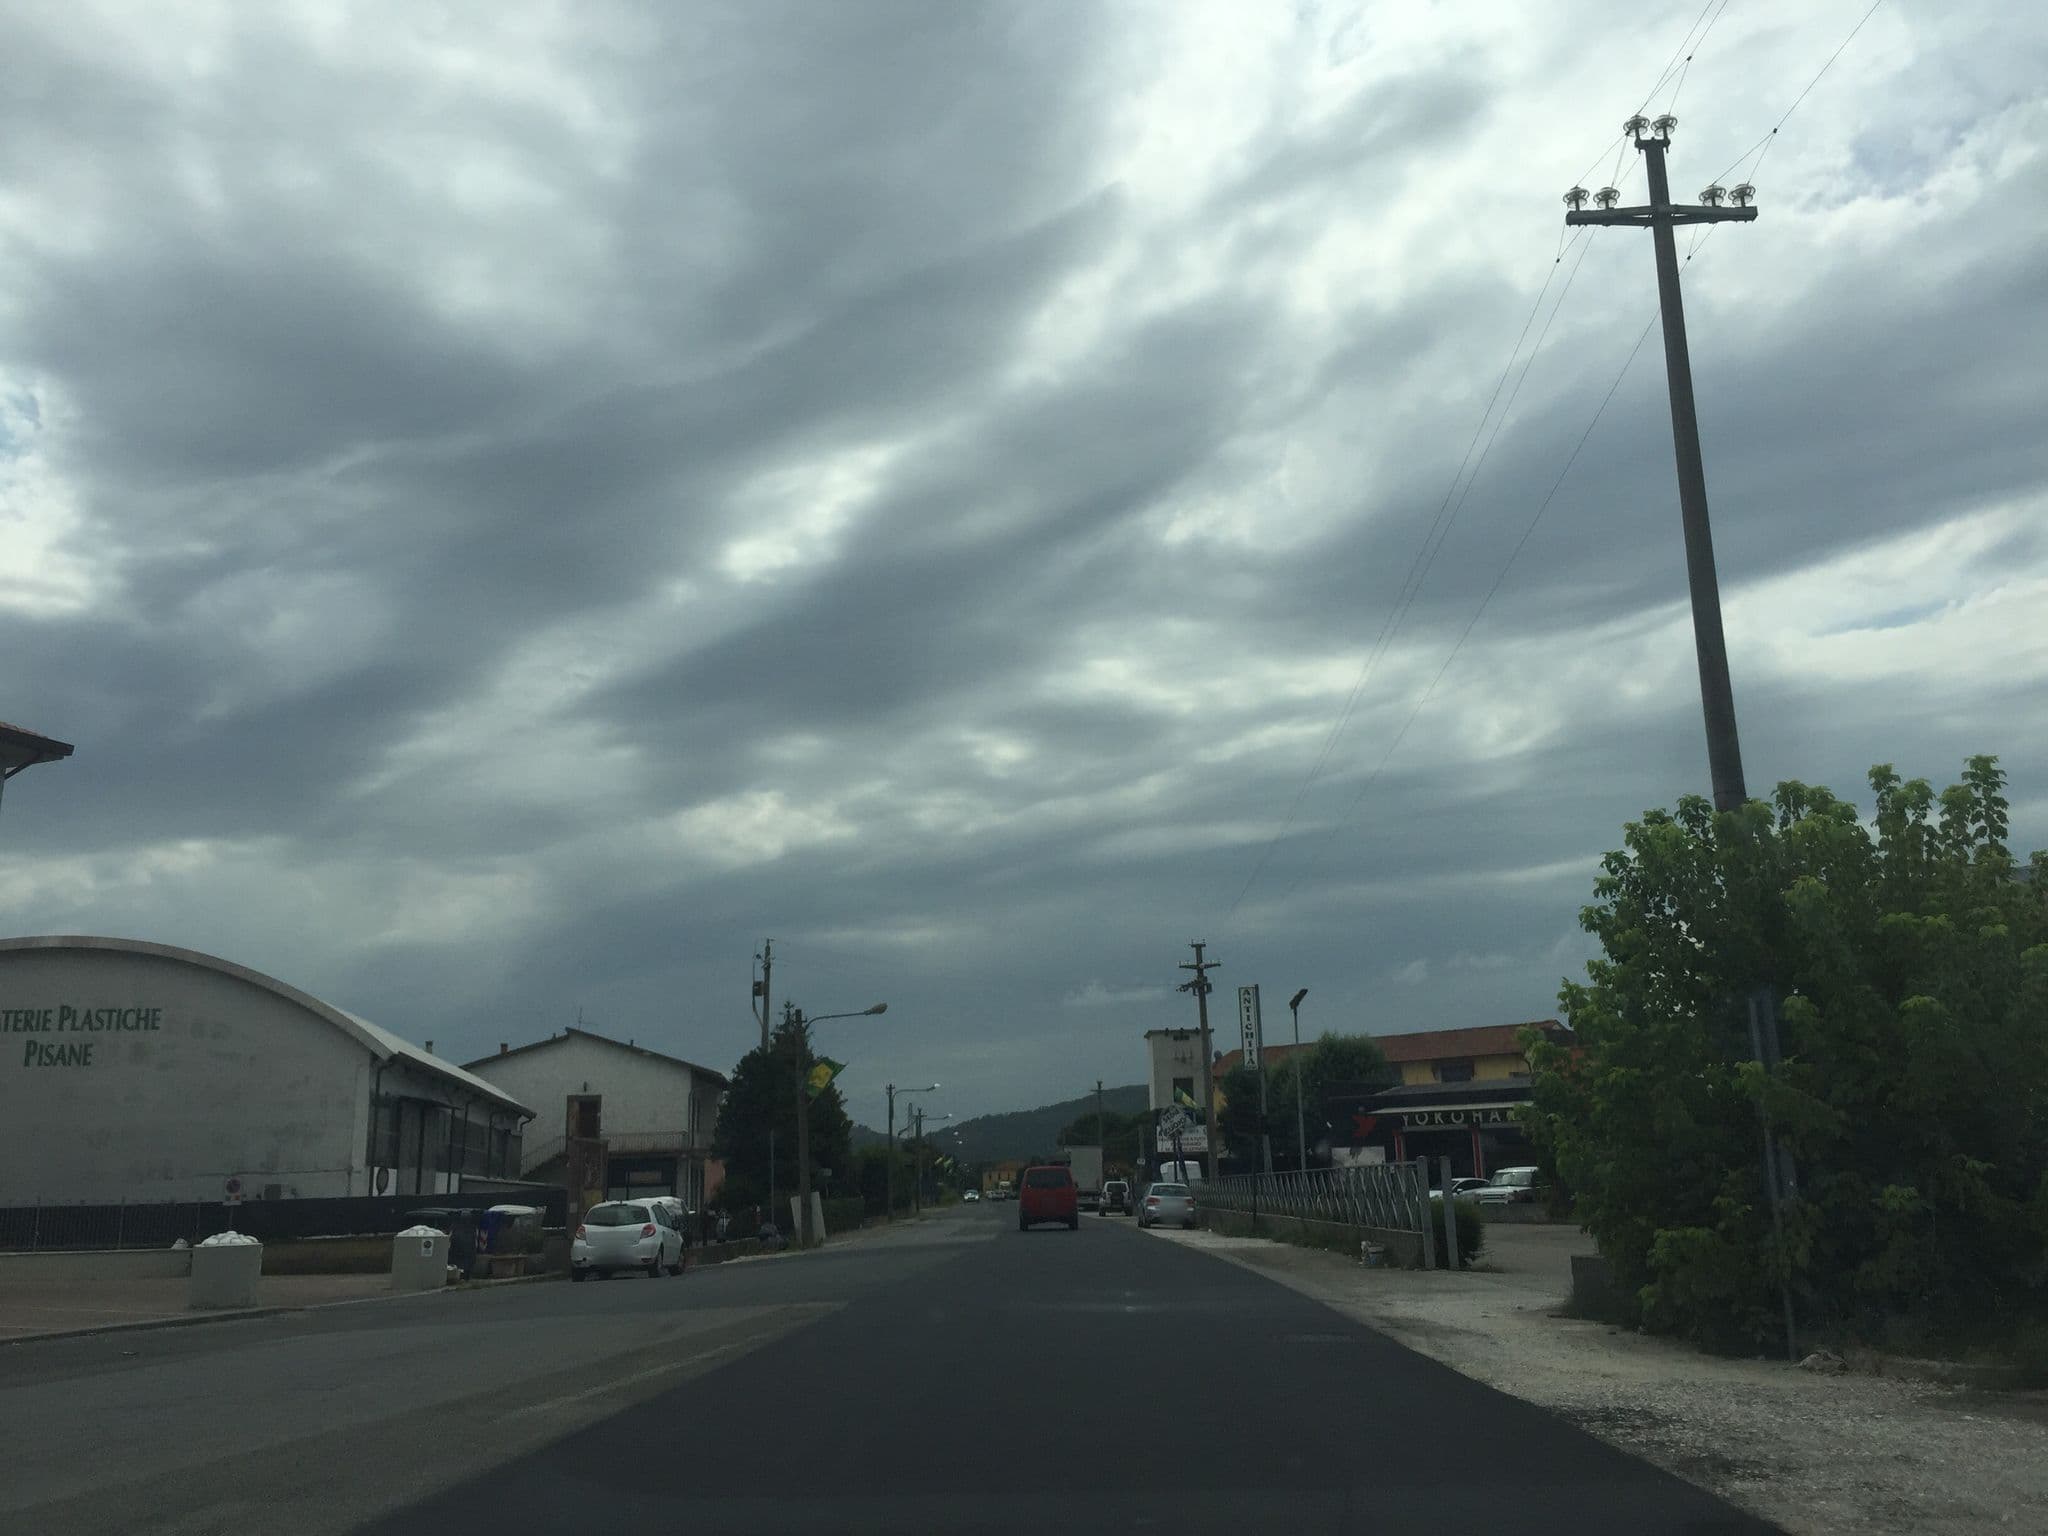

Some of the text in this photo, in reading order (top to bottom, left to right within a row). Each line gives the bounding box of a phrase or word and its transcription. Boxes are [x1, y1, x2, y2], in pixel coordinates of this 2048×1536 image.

[0, 1005, 162, 1033] TERIE PLASTICHE
[24, 1040, 94, 1067] PISANE
[1401, 1110, 1510, 1127] YOKOHA
